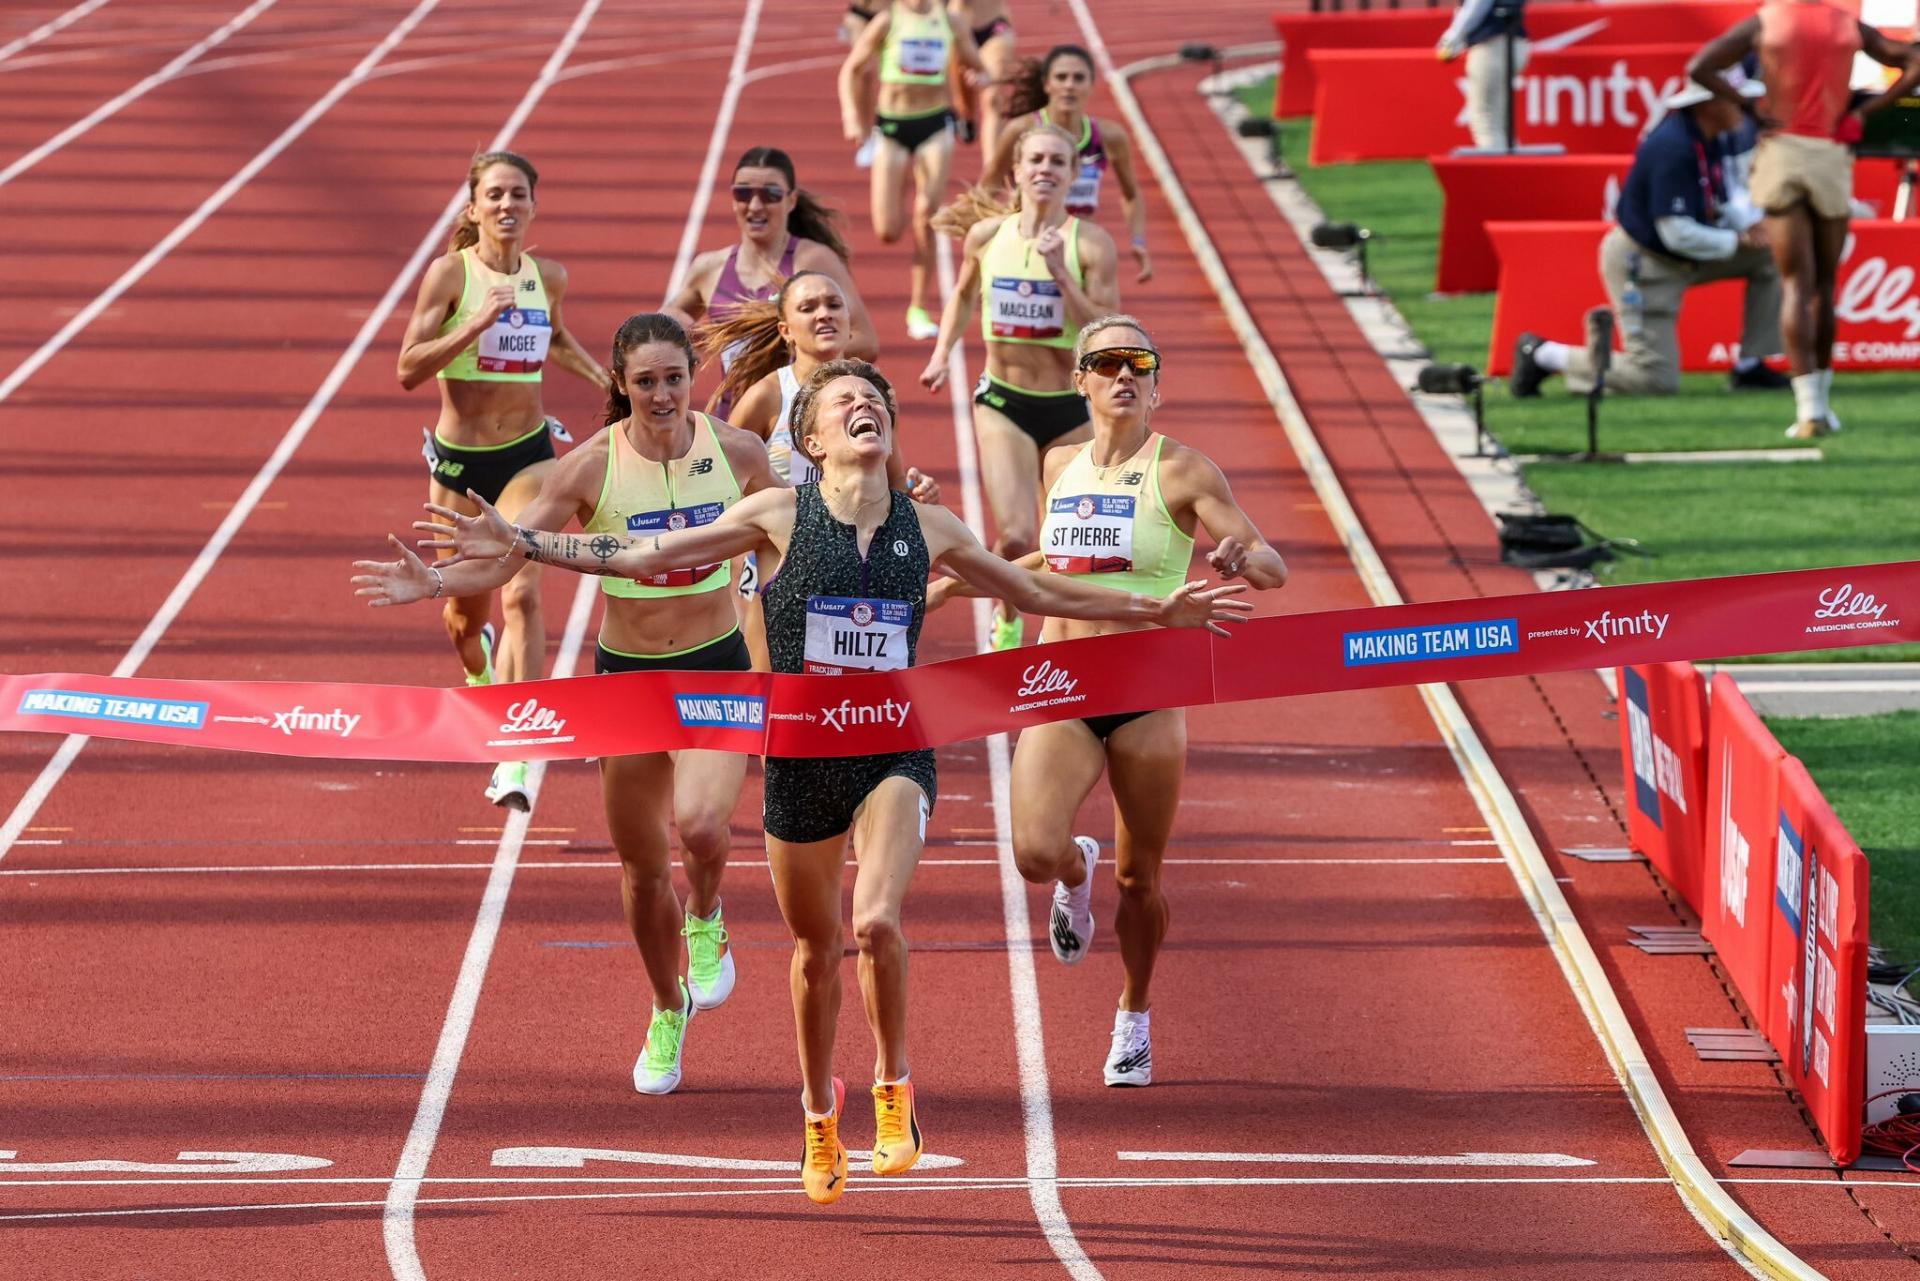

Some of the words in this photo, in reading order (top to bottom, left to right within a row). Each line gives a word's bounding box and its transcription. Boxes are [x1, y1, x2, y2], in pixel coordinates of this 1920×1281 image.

[1455, 60, 1680, 142] inity
[1000, 301, 1054, 319] MACLEAN
[499, 334, 536, 352] MCGEE
[1052, 527, 1067, 546] ST
[1071, 527, 1121, 547] PIERRE
[1815, 583, 1887, 619] Lilly
[1350, 633, 1418, 660] MAKING
[1422, 628, 1469, 654] TEAM
[1475, 625, 1512, 649] USA
[1528, 628, 1568, 640] presented
[1570, 626, 1580, 636] by
[1584, 609, 1670, 644] xfinity
[1813, 623, 1855, 632] MEDICINE
[1856, 619, 1900, 629] COMPANY
[834, 630, 888, 657] HILTZ
[1018, 660, 1078, 697] Lilly
[24, 693, 102, 714] MAKING
[104, 699, 157, 720] TEAM
[157, 704, 199, 724] USA
[271, 705, 361, 737] xfinity
[500, 698, 567, 736] Lilly
[678, 699, 721, 721] MAKING
[721, 700, 748, 723] TEAM
[748, 702, 763, 724] USA
[806, 714, 817, 722] by
[821, 698, 911, 732] xfinity
[1015, 700, 1049, 712] MEDICINE
[1048, 694, 1087, 706] COMPANY
